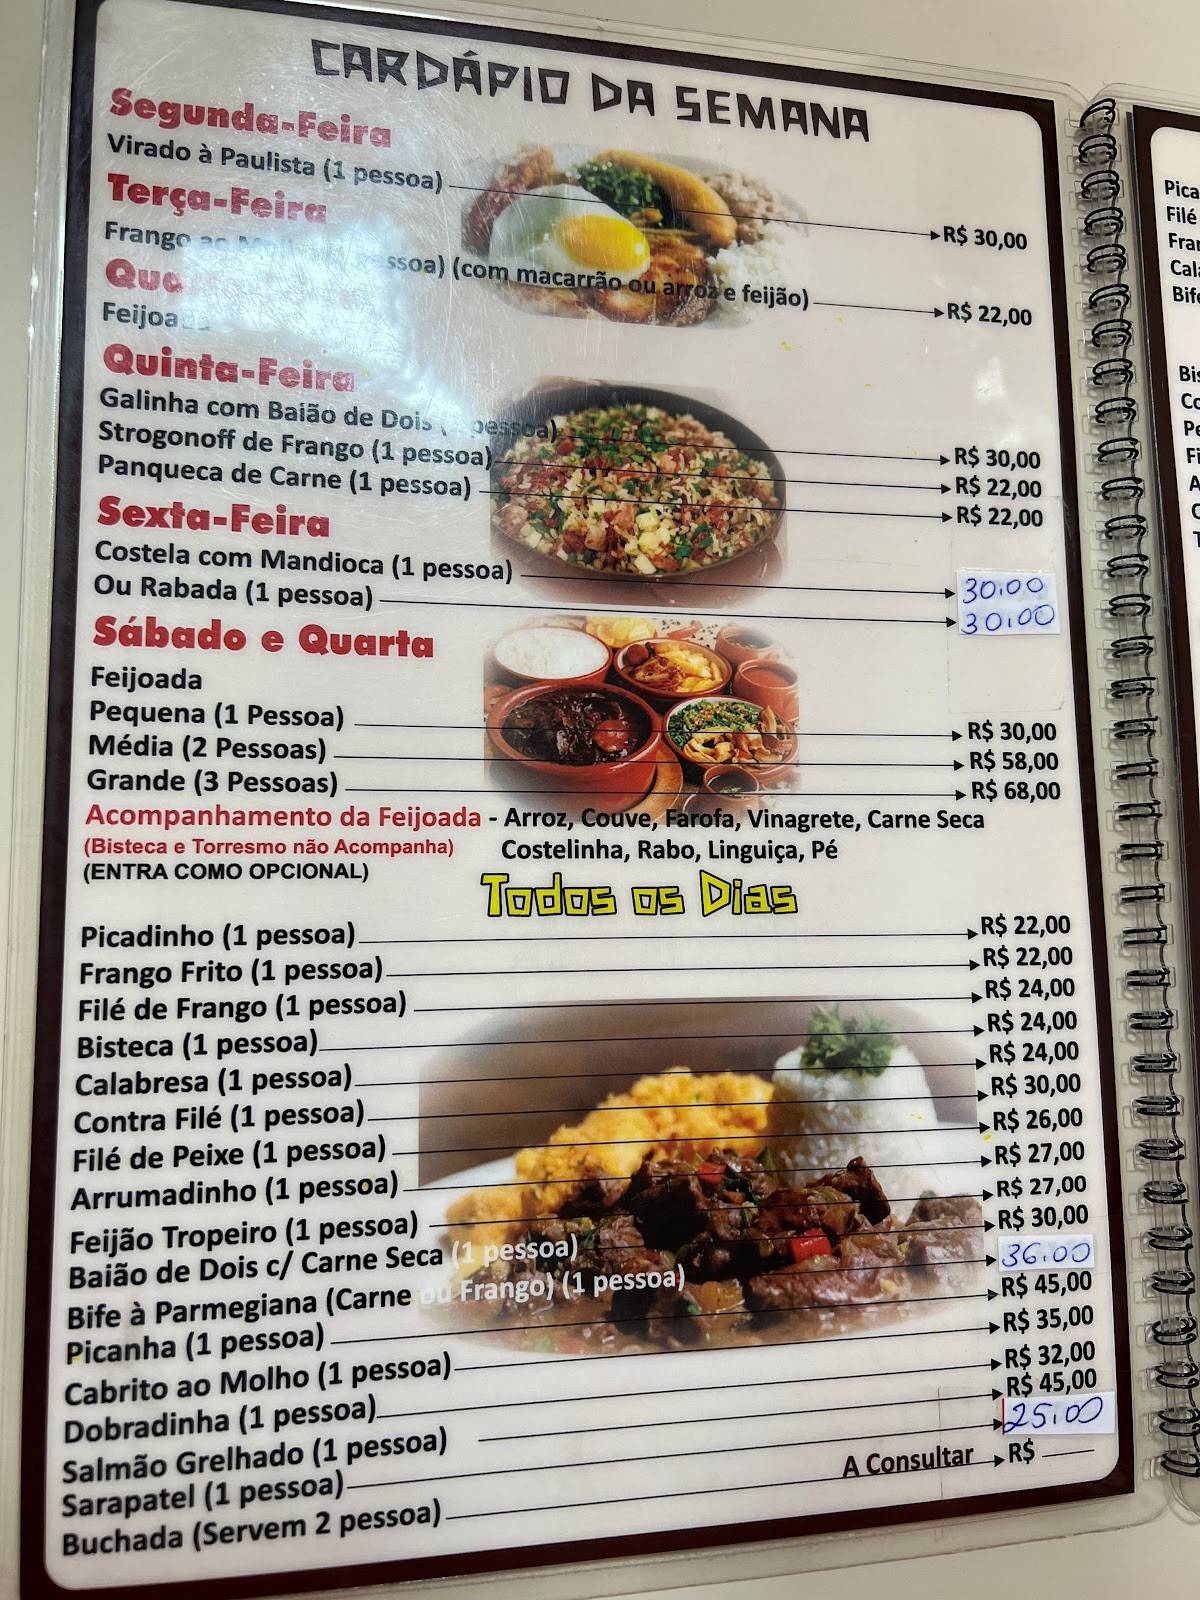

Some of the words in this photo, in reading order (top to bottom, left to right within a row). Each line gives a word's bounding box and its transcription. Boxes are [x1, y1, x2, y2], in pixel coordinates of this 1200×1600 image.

[311, 38, 570, 105] CARDÁPIO
[591, 72, 655, 117] DA
[675, 84, 870, 142] SEMANA
[110, 88, 391, 148] Segunda-Feira
[108, 133, 190, 161] Virado
[199, 144, 212, 164] à
[221, 147, 314, 176] Paulista
[353, 165, 442, 194] pessoa)
[108, 173, 327, 224] Terça-Feira
[1166, 205, 1197, 225] Filé
[973, 228, 1027, 250] 30,00
[105, 221, 191, 251] Frango
[454, 260, 508, 282] (com
[517, 265, 621, 292] macarrão
[629, 278, 656, 295] ou
[663, 280, 720, 300] arroz
[724, 285, 735, 301] e
[743, 283, 809, 311] feijão)
[978, 306, 1032, 326] 22,00
[103, 344, 355, 392] Quinta-Feira
[100, 388, 198, 414] Galinha
[207, 400, 259, 419] com
[268, 400, 337, 426] Baião
[344, 407, 373, 428] de
[382, 410, 432, 432] Dois
[99, 421, 235, 455] Strogonoff
[242, 430, 273, 452] de
[282, 439, 364, 464] Frango
[402, 444, 493, 471] pessoa)
[987, 449, 1040, 470] 30,00
[99, 455, 223, 487] Panqueca
[232, 463, 262, 485] de
[270, 467, 341, 489] Carne
[988, 478, 1042, 499] 22,00
[97, 496, 330, 538] Sexta-Feira
[988, 507, 1043, 528] 22,00
[95, 541, 190, 566] Costela
[198, 549, 252, 568] com
[261, 550, 384, 575] Mandioca
[423, 560, 512, 585] pessoa)
[94, 575, 132, 598] Ou
[141, 577, 237, 600] Rabada
[93, 616, 246, 652] Sábado
[262, 629, 284, 653] e
[299, 623, 434, 658] Quarta
[91, 666, 202, 693] Feijoada
[90, 702, 205, 729] Pequena
[248, 705, 344, 731] Pessoa)
[1000, 722, 1056, 743] 30,00
[89, 734, 174, 757] Média
[182, 737, 208, 761] (2
[217, 738, 326, 763] Pessoas)
[1002, 752, 1058, 773] 58,00
[87, 769, 185, 791] Grande
[194, 771, 218, 796] (3
[228, 772, 338, 797] Pessoas)
[1004, 781, 1060, 803] 68,00
[86, 805, 332, 830] Acompanhamento
[340, 807, 370, 827] da
[379, 807, 481, 831] Feijoada
[504, 808, 574, 831] Arroz,
[582, 808, 658, 831] Couve,
[666, 808, 738, 832] Farofa,
[748, 808, 861, 834] Vinagrete,
[868, 810, 930, 829] Carne
[936, 810, 984, 829] Seca
[84, 838, 167, 858] (Bisteca
[175, 843, 185, 855] e
[192, 839, 286, 855] Torresmo
[293, 839, 328, 856] não
[335, 838, 454, 859] Acompanha)
[502, 840, 630, 864] Costelinha,
[638, 840, 701, 863] Rabo,
[708, 840, 804, 864] Linguiça,
[812, 839, 838, 859] Pé
[84, 862, 166, 882] (ENTRA
[175, 862, 242, 880] COMO
[249, 862, 368, 882] OPCIONAL)
[481, 872, 616, 918] Todos
[632, 885, 684, 916] os
[700, 870, 798, 916] Dias
[81, 925, 214, 948] Picadinho
[256, 922, 355, 950] pessoa)
[1014, 915, 1070, 937] 22,00
[1016, 946, 1073, 969] 22,00
[80, 963, 172, 988] Frango
[181, 960, 242, 983] Frito
[1018, 978, 1075, 1000] 24,00
[79, 999, 125, 1022] Filé
[134, 998, 167, 1020] de
[176, 997, 266, 1023] Frango
[309, 991, 406, 1019] pessoa)
[1020, 1011, 1077, 1034] 24,00
[78, 1036, 173, 1058] Bisteca
[1022, 1041, 1079, 1065] 24,00
[76, 1071, 208, 1097] Calabresa
[251, 1064, 352, 1094] pessoa)
[1024, 1073, 1081, 1097] 30,00
[74, 1109, 165, 1134] Contra
[175, 1106, 221, 1130] Filé
[1026, 1107, 1082, 1131] 26,00
[73, 1148, 121, 1172] Filé
[130, 1146, 163, 1169] de
[172, 1144, 244, 1168] Peixe
[287, 1135, 385, 1164] pessoa)
[1028, 1141, 1084, 1166] 27,00
[71, 1180, 256, 1210] Arrumadinho
[1029, 1175, 1086, 1197] 27,00
[1031, 1205, 1088, 1229] 30,00
[70, 1230, 153, 1256] Feijão
[162, 1225, 277, 1255] Tropeiro
[320, 1210, 418, 1240] pessoa)
[70, 1263, 147, 1289] Baião
[156, 1261, 190, 1284] de
[200, 1256, 258, 1281] Dois
[266, 1251, 294, 1280] c/
[301, 1248, 377, 1274] Carne
[385, 1245, 443, 1269] Seca
[68, 1305, 121, 1329] Bife
[129, 1301, 146, 1326] à
[155, 1290, 317, 1324] Parmegiana
[325, 1286, 411, 1317] (Carne
[461, 1272, 554, 1303] Frango)
[593, 1264, 685, 1298] pessoa)
[1035, 1271, 1092, 1295] 45,00
[1036, 1305, 1093, 1332] 35,00
[66, 1337, 176, 1364] Picanha
[1038, 1341, 1095, 1368] 32,00
[65, 1378, 167, 1406] Cabrito
[177, 1375, 211, 1398] ao
[221, 1366, 309, 1394] Molho
[352, 1352, 451, 1384] pessoa)
[1040, 1369, 1096, 1395] 45,00
[65, 1412, 230, 1444] Dobradinha
[63, 1453, 166, 1484] Salmão
[176, 1442, 304, 1475] Grelhado
[347, 1428, 447, 1464] pessoa)
[843, 1456, 859, 1477] A
[866, 1447, 974, 1473] Consultar
[1009, 1438, 1034, 1464] R$
[62, 1485, 195, 1519] Sarapatel
[64, 1524, 184, 1556] Buchada
[193, 1517, 306, 1552] (Servem
[316, 1512, 330, 1535] 2
[340, 1499, 441, 1533] pessoa)
